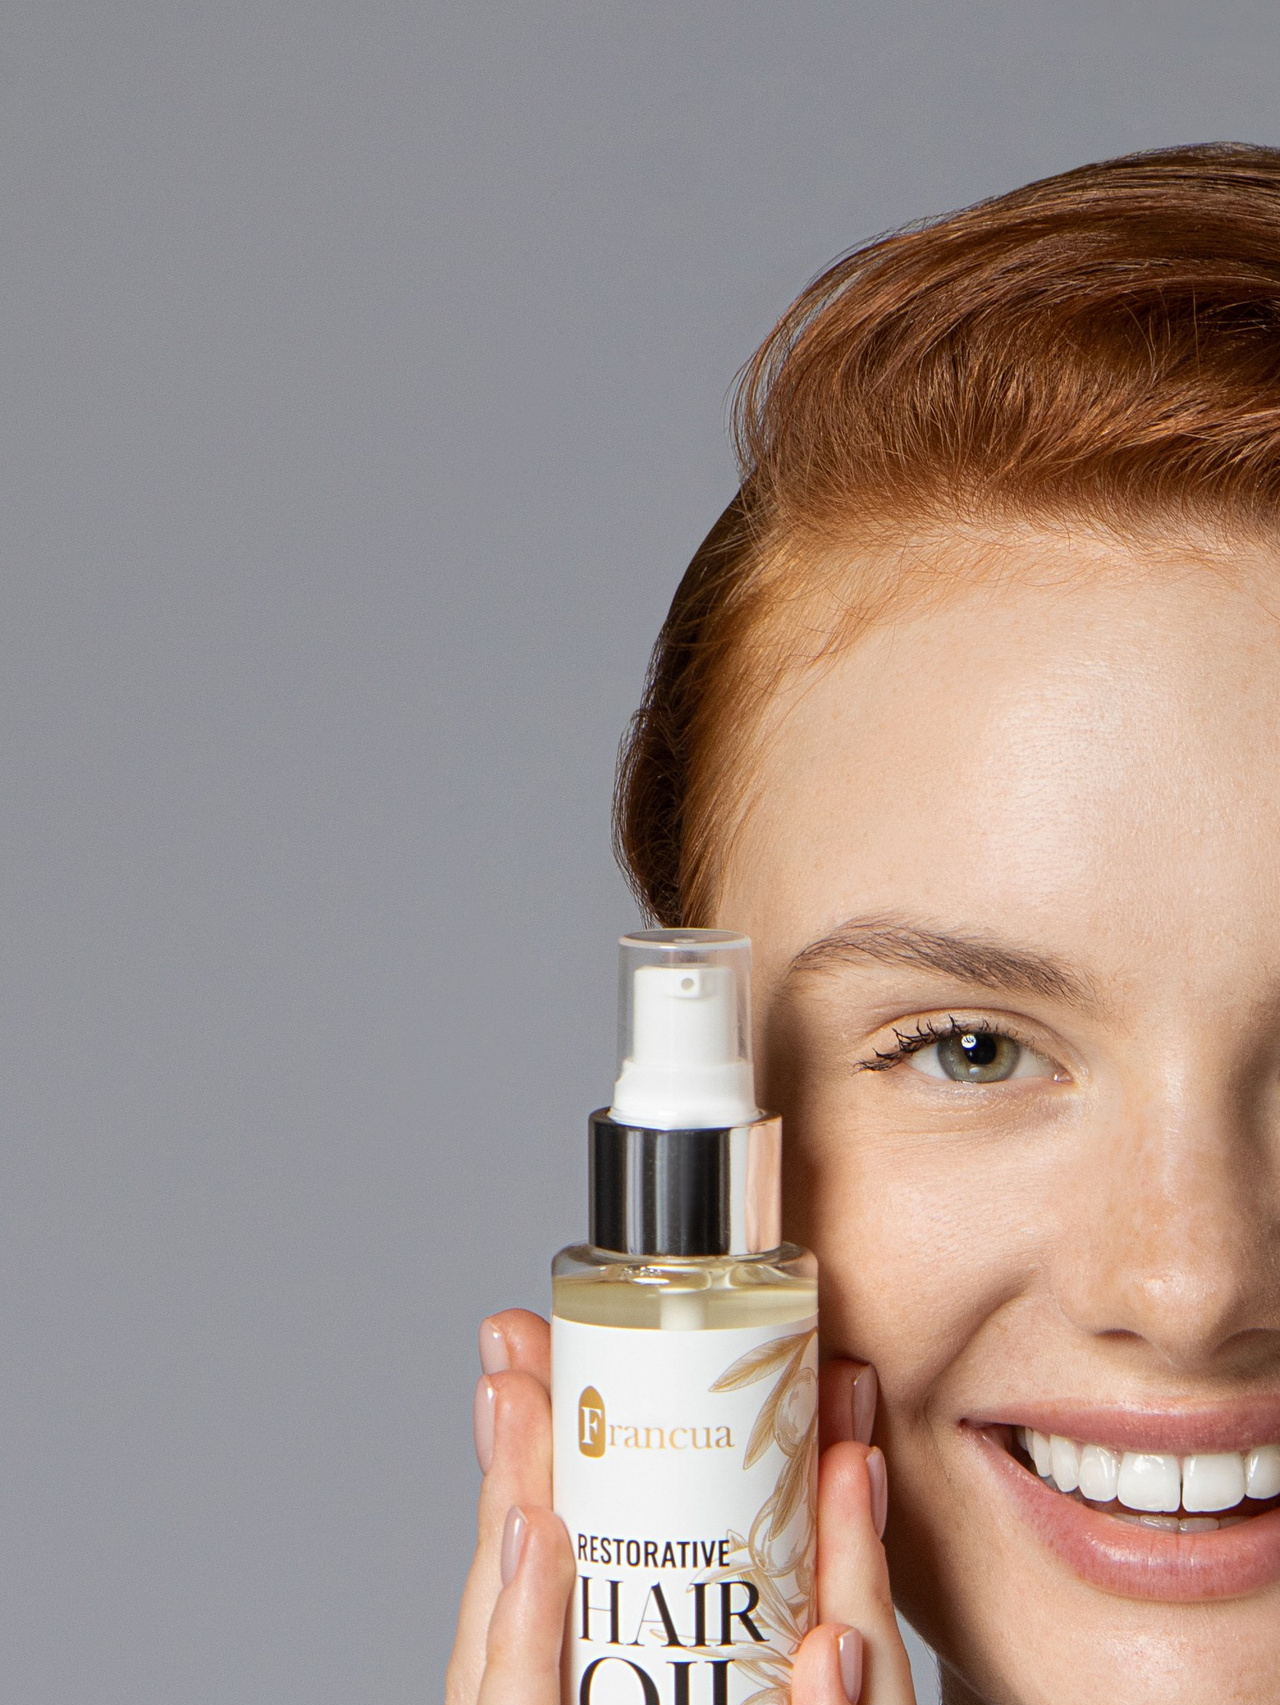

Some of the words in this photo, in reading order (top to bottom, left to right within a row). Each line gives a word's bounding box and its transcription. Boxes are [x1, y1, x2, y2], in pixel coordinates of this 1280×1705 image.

[581, 1406, 735, 1450] Francua
[578, 1532, 730, 1569] RESTORATIVE
[578, 1574, 770, 1648] HAIR
